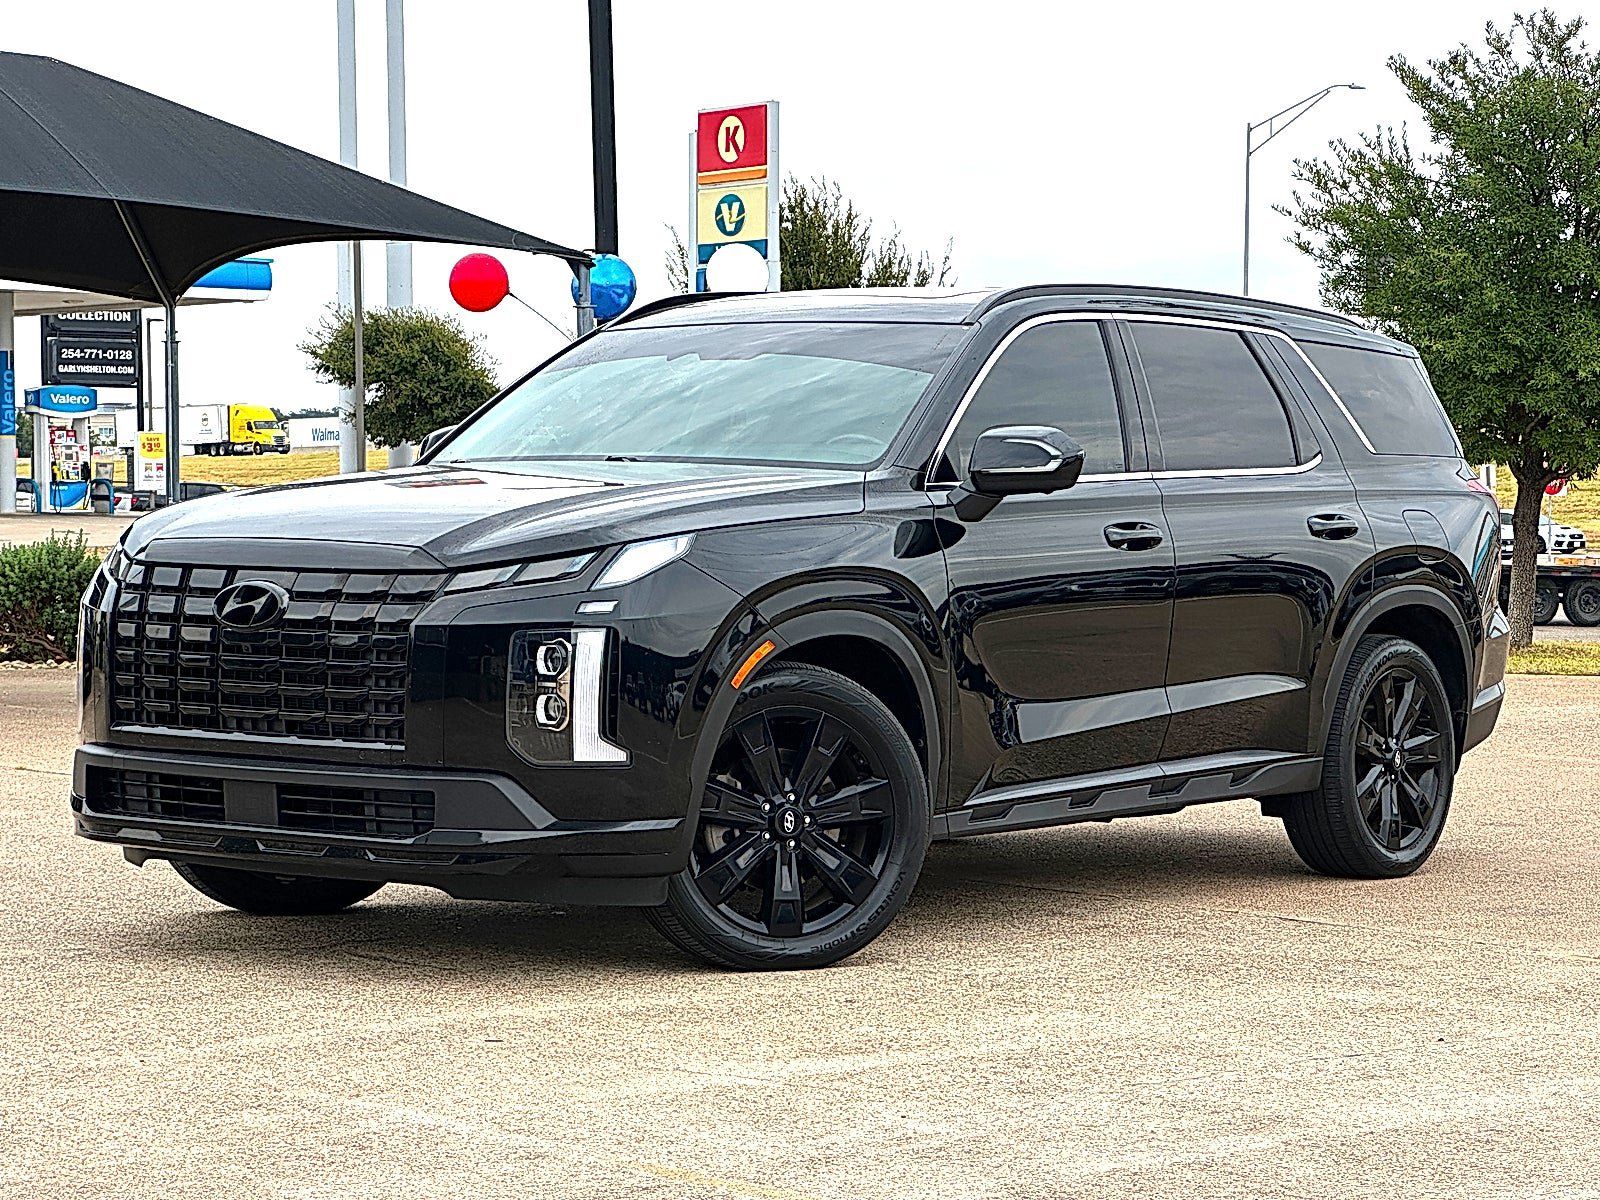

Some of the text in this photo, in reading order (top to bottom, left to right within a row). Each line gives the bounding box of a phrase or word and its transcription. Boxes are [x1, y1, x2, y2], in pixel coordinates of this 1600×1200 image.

[724, 125, 742, 156] K
[61, 348, 133, 360] 254-771-0128
[58, 364, 135, 374] GARLYNSHELTON.COM
[2, 369, 15, 434] Valero
[50, 393, 90, 405] Valero
[311, 428, 340, 442] Walma
